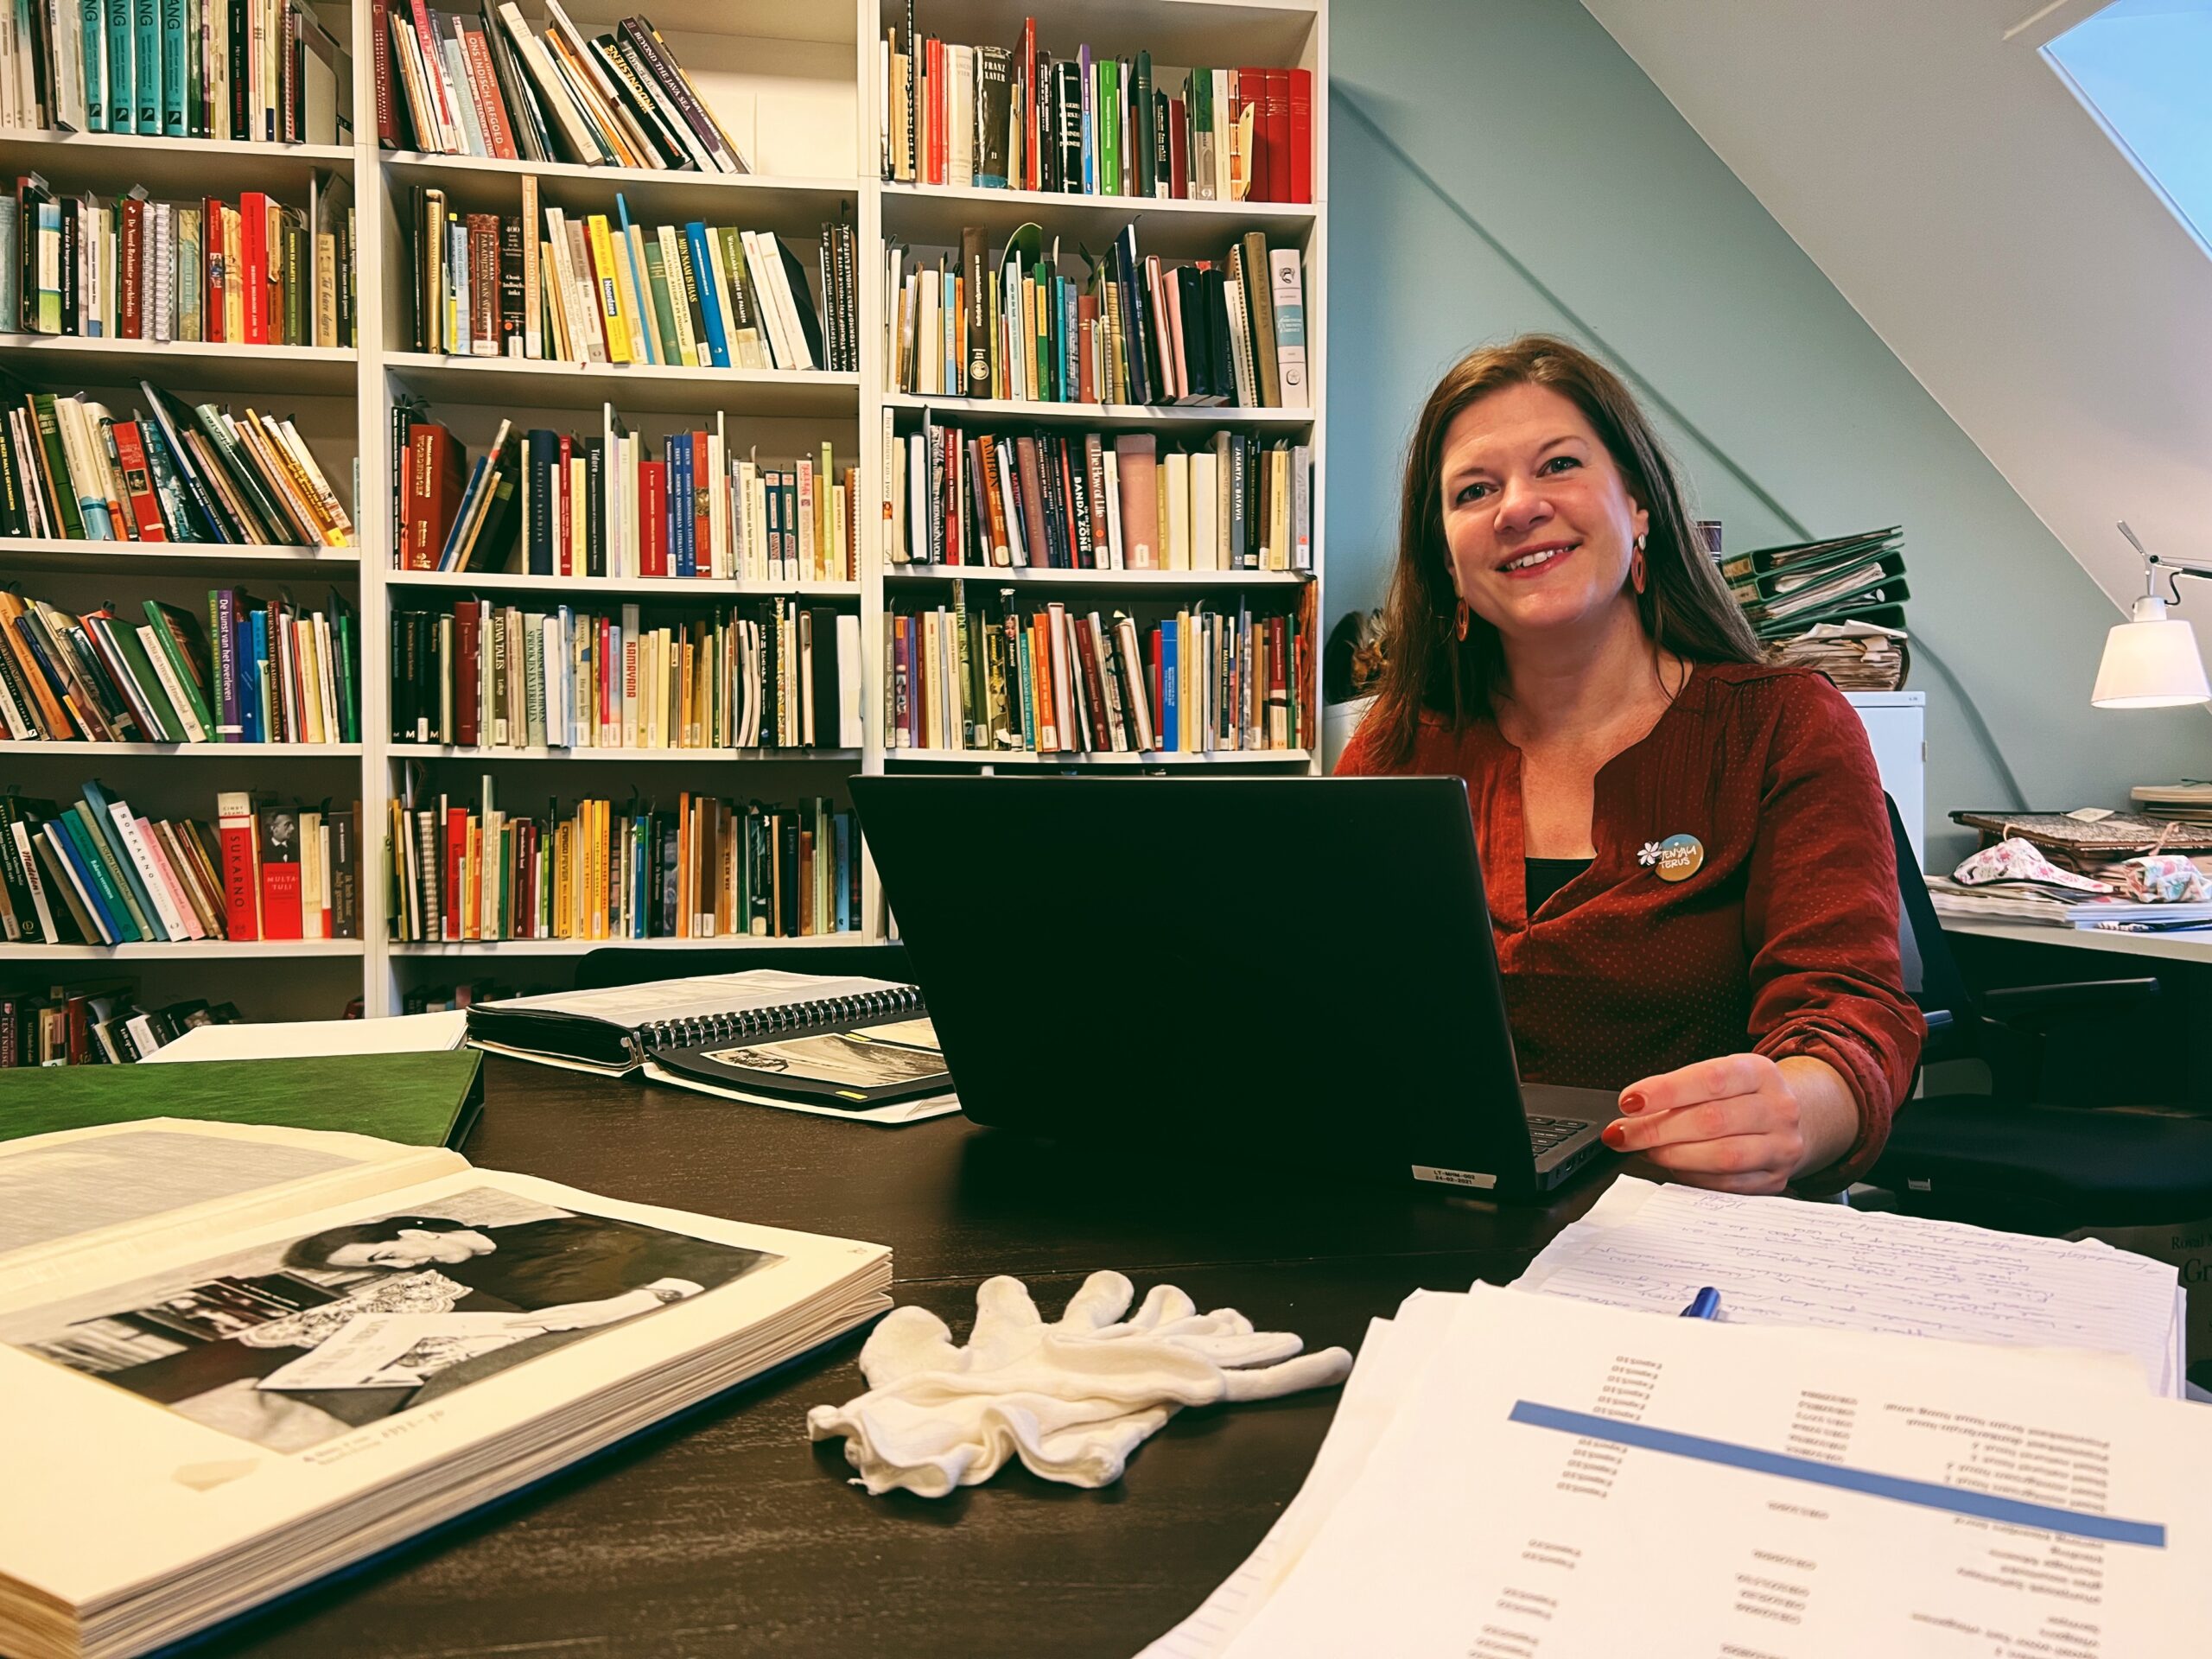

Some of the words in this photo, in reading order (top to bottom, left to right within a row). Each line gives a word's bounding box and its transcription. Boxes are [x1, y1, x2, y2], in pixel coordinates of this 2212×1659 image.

[633, 32, 652, 61] BEYOND
[653, 61, 666, 80] THE
[664, 79, 680, 96] JAVA
[677, 96, 690, 111] SEA
[984, 62, 1006, 73] FRANZ
[984, 73, 1006, 83] XAVER
[469, 37, 480, 56] ONS
[476, 59, 492, 98] INDISCH
[486, 101, 503, 144] ERFGOED
[127, 219, 136, 227] De
[127, 228, 136, 279] Noord-Brabantse
[678, 238, 690, 255] MIJN
[681, 256, 692, 276] NAAM
[727, 235, 738, 270] WANDELAAR
[733, 271, 741, 291] ONDER
[737, 301, 747, 323] PALMEN
[125, 279, 135, 317] geschiedenis
[605, 280, 615, 315] Noordzee
[685, 283, 697, 302] HAAS
[591, 448, 601, 473] Tidore
[982, 440, 998, 487] AMBON
[1090, 447, 1102, 467] The
[4, 476, 16, 511] GEVANGENIS
[1074, 476, 1085, 517] BANDA
[1092, 489, 1103, 498] of
[1095, 501, 1105, 518] Life
[1077, 521, 1089, 551] ZONE
[219, 599, 229, 610] De
[213, 629, 218, 638] EN
[220, 611, 231, 632] kunst
[221, 634, 231, 648] van
[222, 649, 232, 662] het
[496, 643, 505, 670] TALES
[223, 663, 233, 701] overleven
[626, 642, 636, 698] RAMAYANA
[119, 813, 154, 879] SOEKARNO
[21, 850, 40, 892] Madelon
[229, 836, 245, 908] SUKARNO
[1658, 856, 1691, 869] TERUS
[2171, 1236, 2203, 1250] Royal
